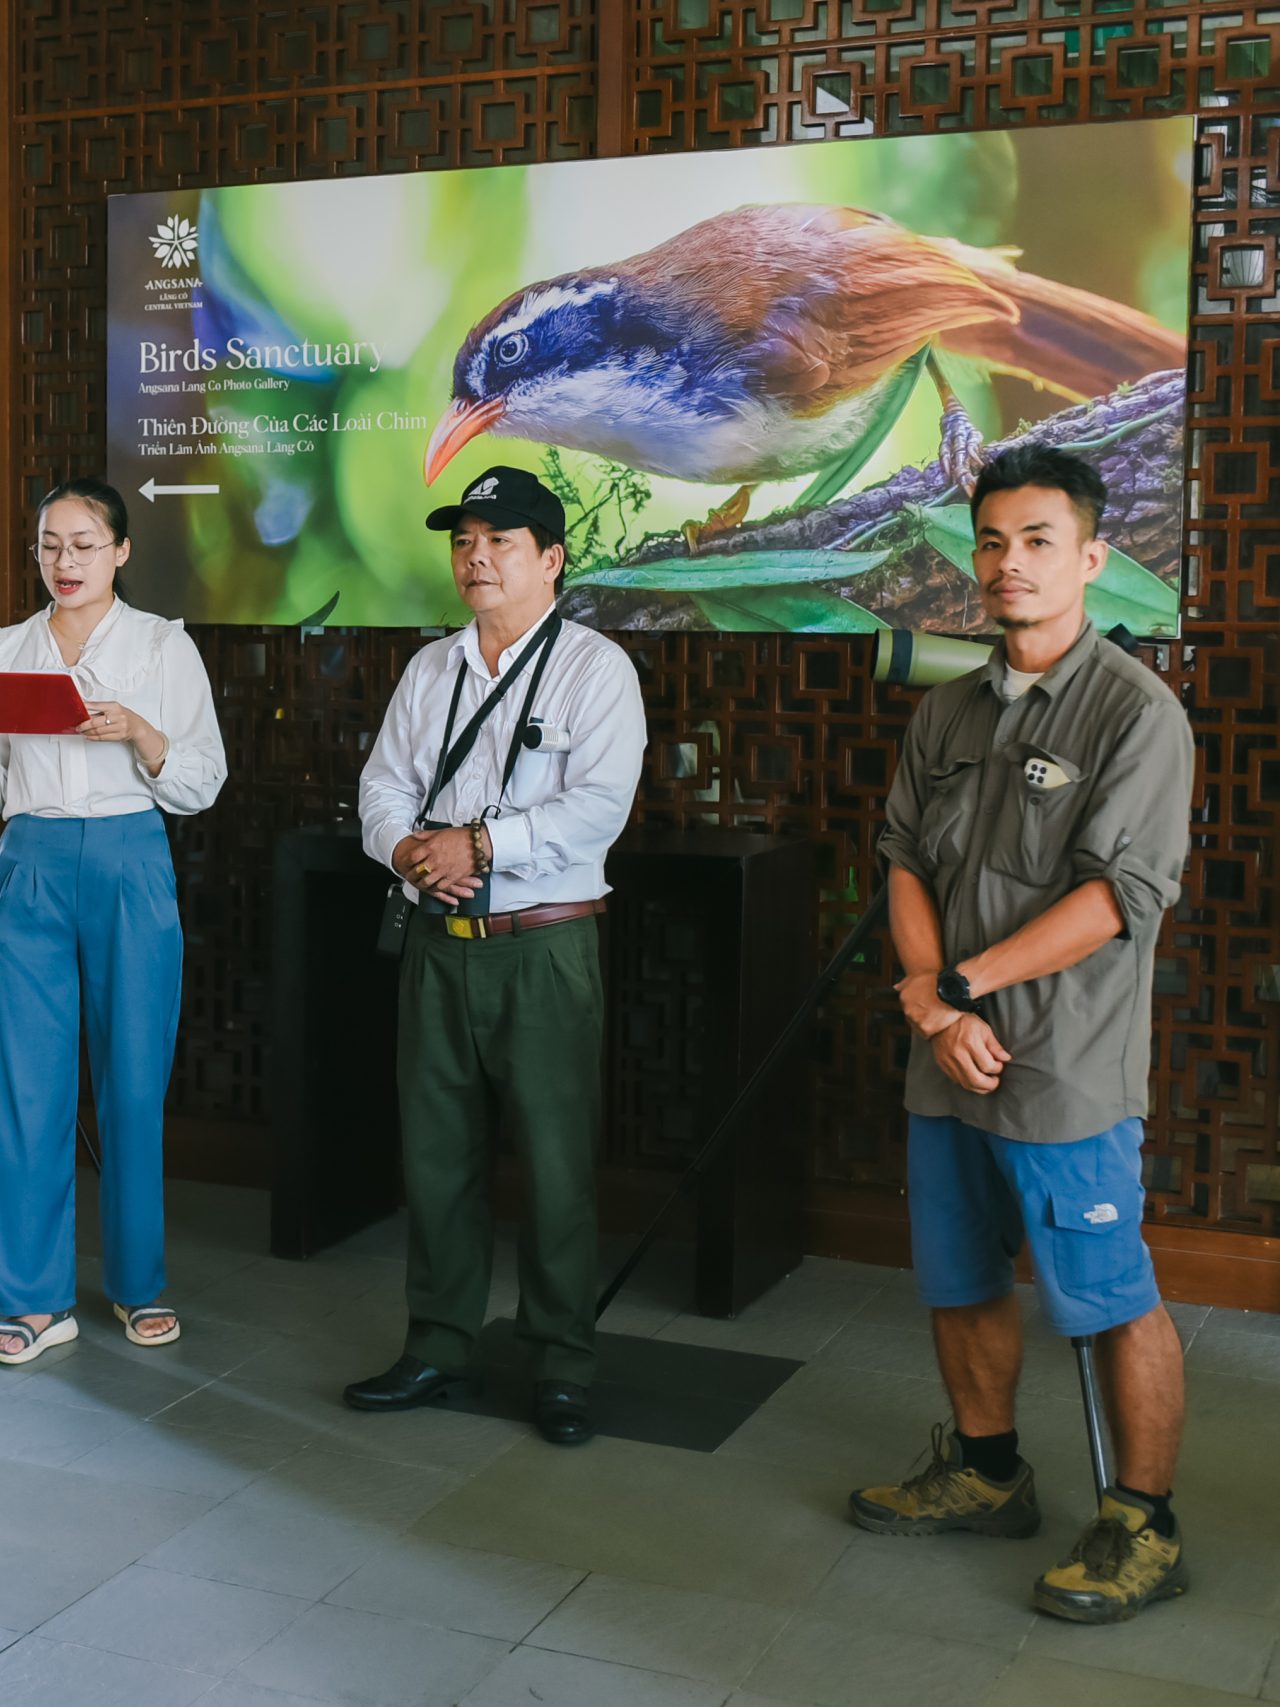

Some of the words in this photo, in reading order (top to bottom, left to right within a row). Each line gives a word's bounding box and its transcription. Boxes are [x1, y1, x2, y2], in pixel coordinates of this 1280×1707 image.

[144, 277, 204, 290] ANGSANA
[144, 303, 173, 311] CENTRAL
[174, 301, 203, 309] VIETNAM
[139, 338, 217, 373] Birds
[226, 336, 385, 372] Sanctuary
[138, 381, 180, 395] Angsana
[182, 380, 206, 393] Lang
[208, 380, 221, 391] Co
[223, 378, 252, 391] Photo
[254, 377, 290, 391] Gallery
[138, 417, 187, 436] Thiên
[190, 416, 250, 439] Đường
[292, 413, 328, 432] Các
[332, 411, 372, 432] Loài
[376, 411, 428, 430] Chim
[219, 442, 264, 456] Angsana
[297, 439, 315, 452] Cô
